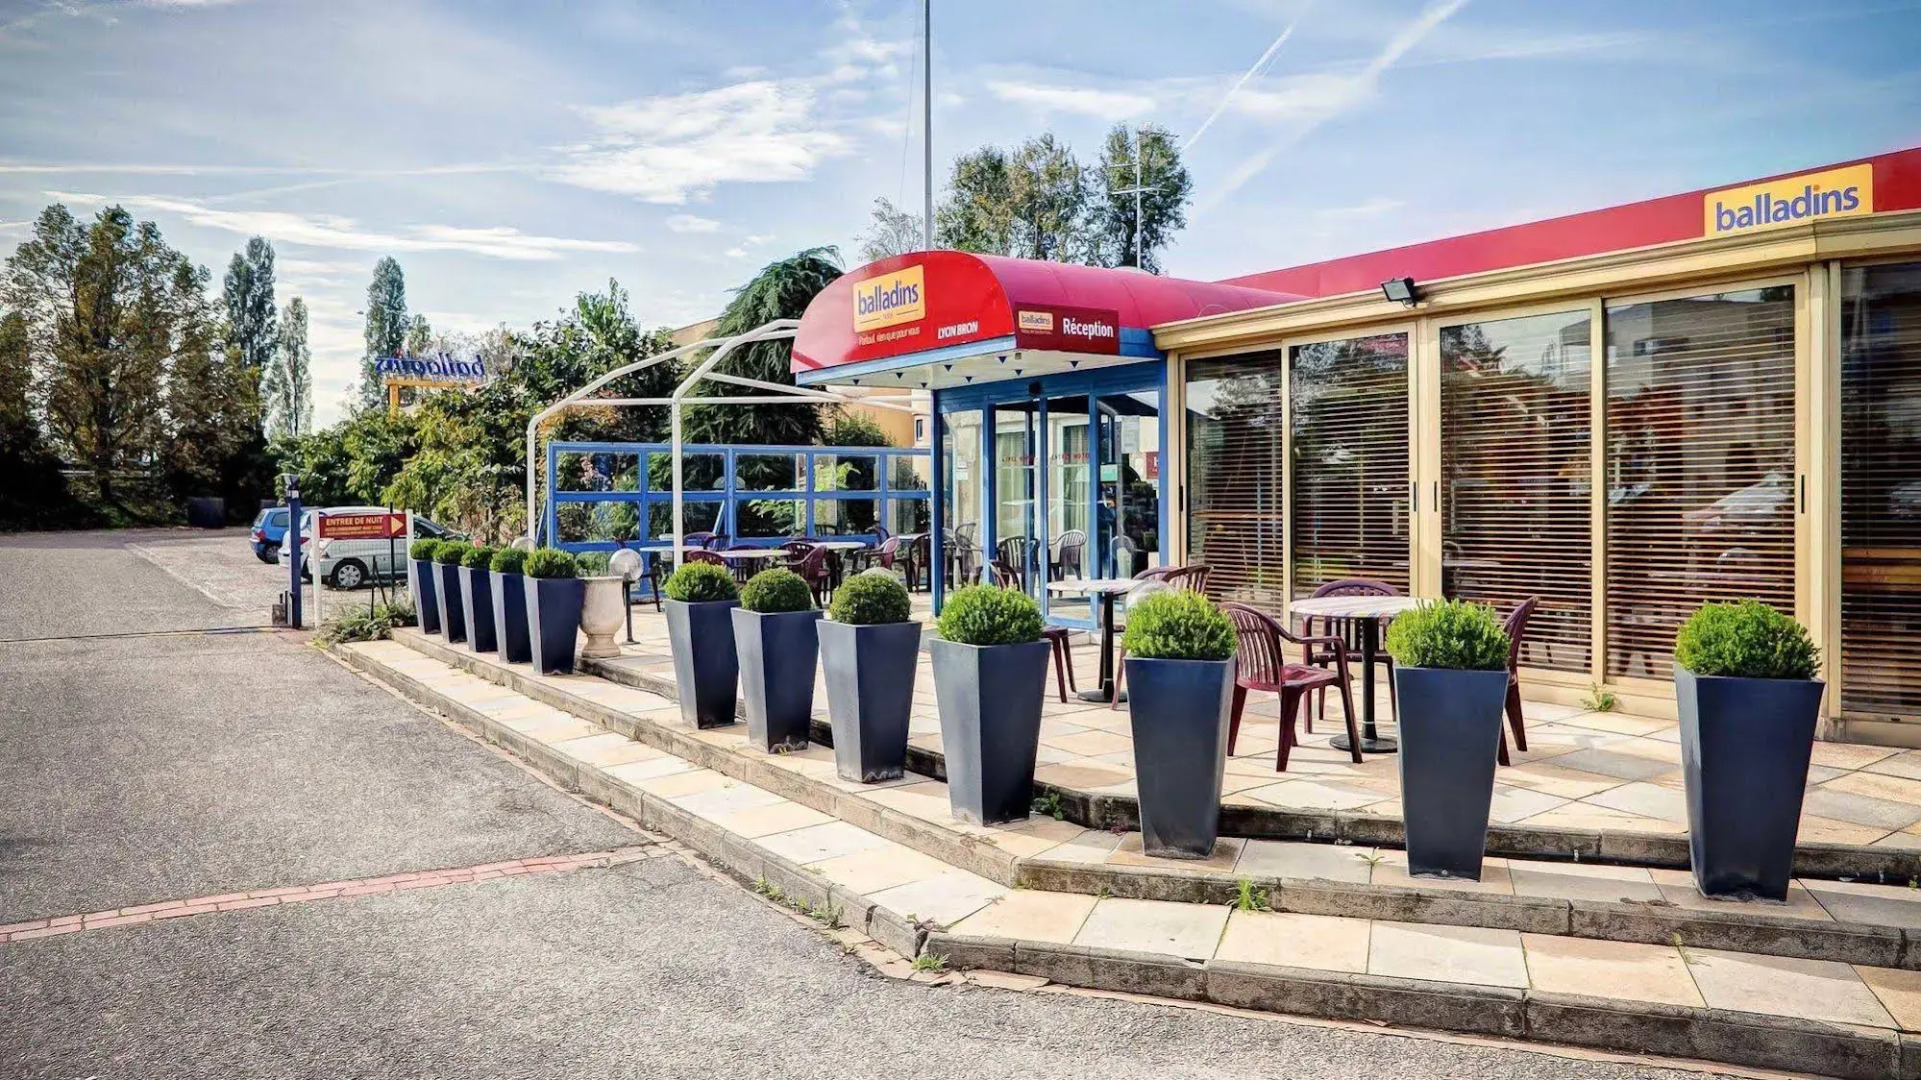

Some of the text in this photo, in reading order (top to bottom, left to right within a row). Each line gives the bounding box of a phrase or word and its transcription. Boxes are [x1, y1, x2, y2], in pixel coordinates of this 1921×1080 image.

[1716, 184, 1859, 231] balladins
[858, 280, 919, 315] balladins
[938, 320, 979, 340] LYON BRON
[1021, 314, 1051, 325] balladins
[1062, 317, 1114, 340] Réception
[354, 517, 365, 525] DE
[365, 516, 384, 524] NUIT
